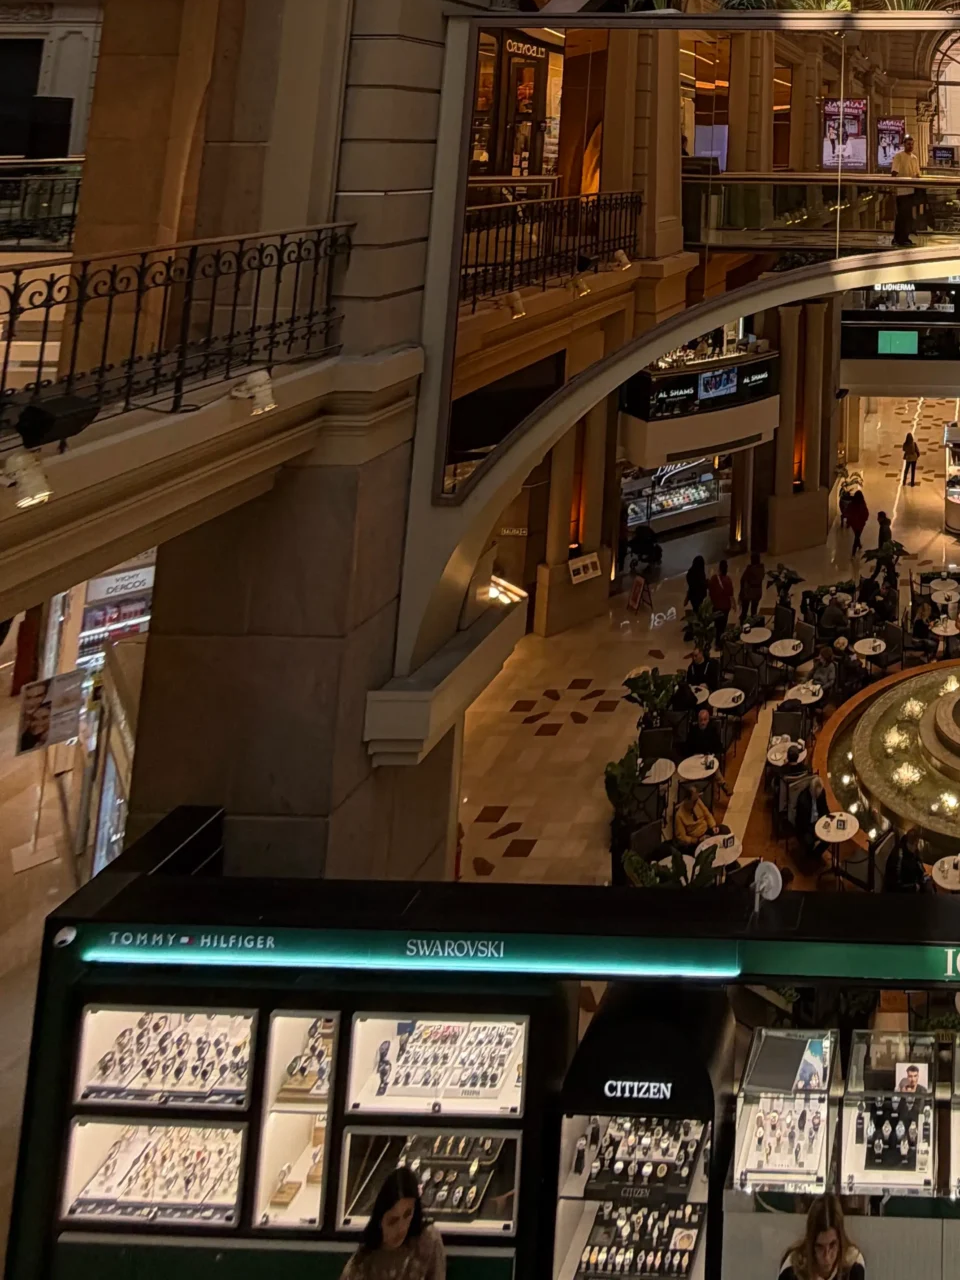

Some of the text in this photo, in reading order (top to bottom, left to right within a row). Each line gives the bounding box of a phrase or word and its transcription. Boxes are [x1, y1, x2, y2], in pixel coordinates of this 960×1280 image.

[882, 283, 916, 291] LIDHERMA
[658, 391, 668, 399] AL
[669, 386, 694, 397] SHAMS
[115, 573, 141, 583] VICHY
[105, 579, 147, 595] DERCOS
[109, 931, 276, 949] TOMMY HILFIGER
[406, 938, 504, 958] SWAROVSKI
[604, 1080, 672, 1099] CITIZEN
[620, 1187, 651, 1198] CITIZEN
